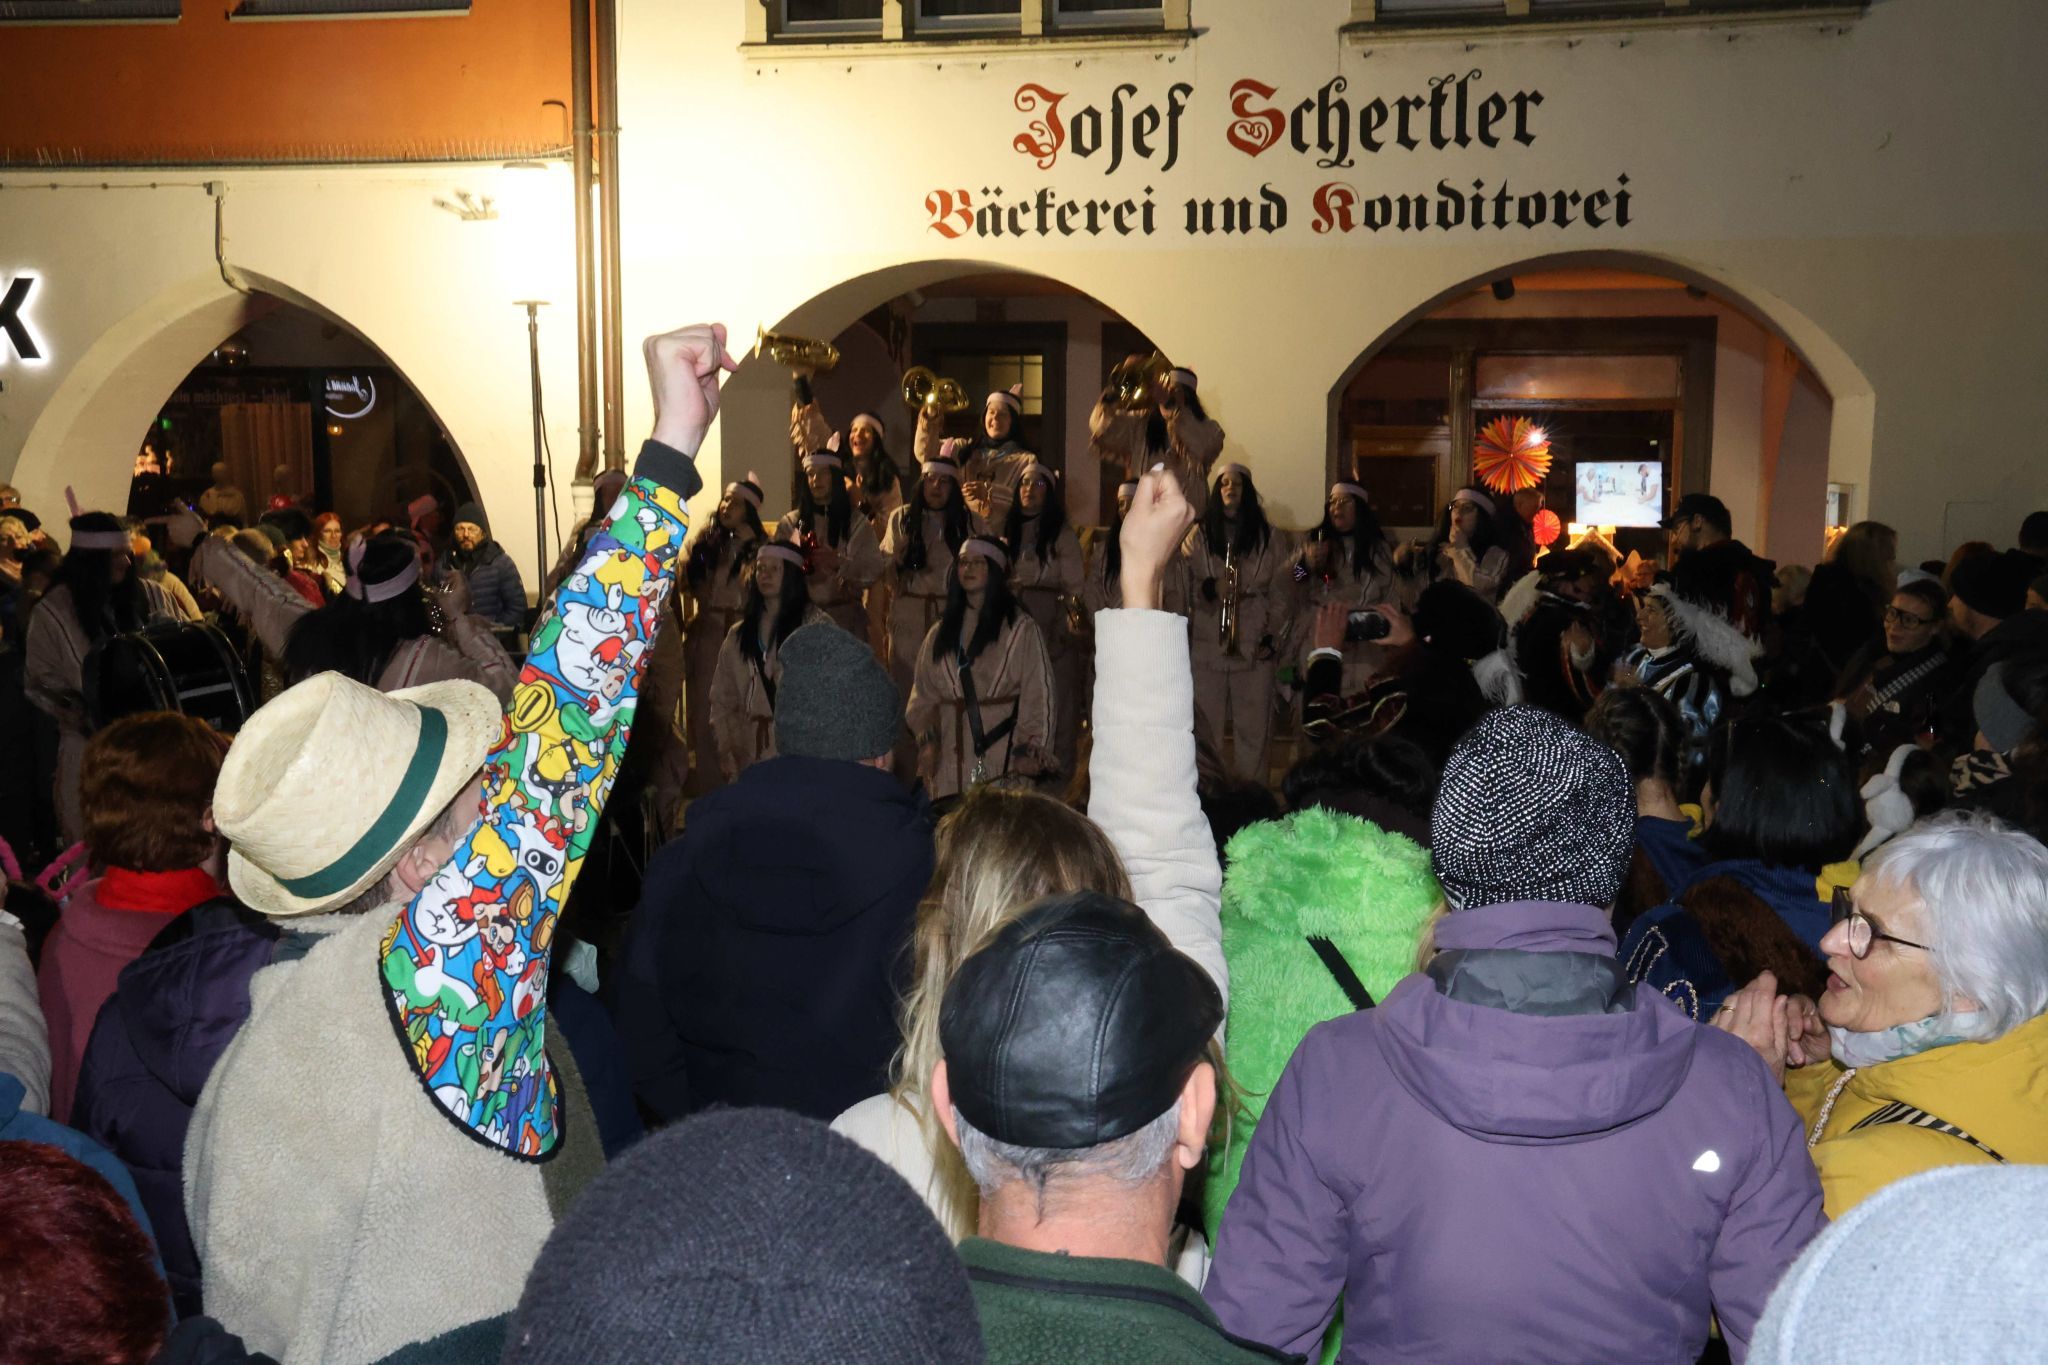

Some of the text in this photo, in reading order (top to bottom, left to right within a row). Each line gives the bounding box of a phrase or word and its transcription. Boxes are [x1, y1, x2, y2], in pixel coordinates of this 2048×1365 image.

[1013, 68, 1545, 176] Josef Schertler
[924, 172, 1632, 240] Bäckerei und Konditorei
